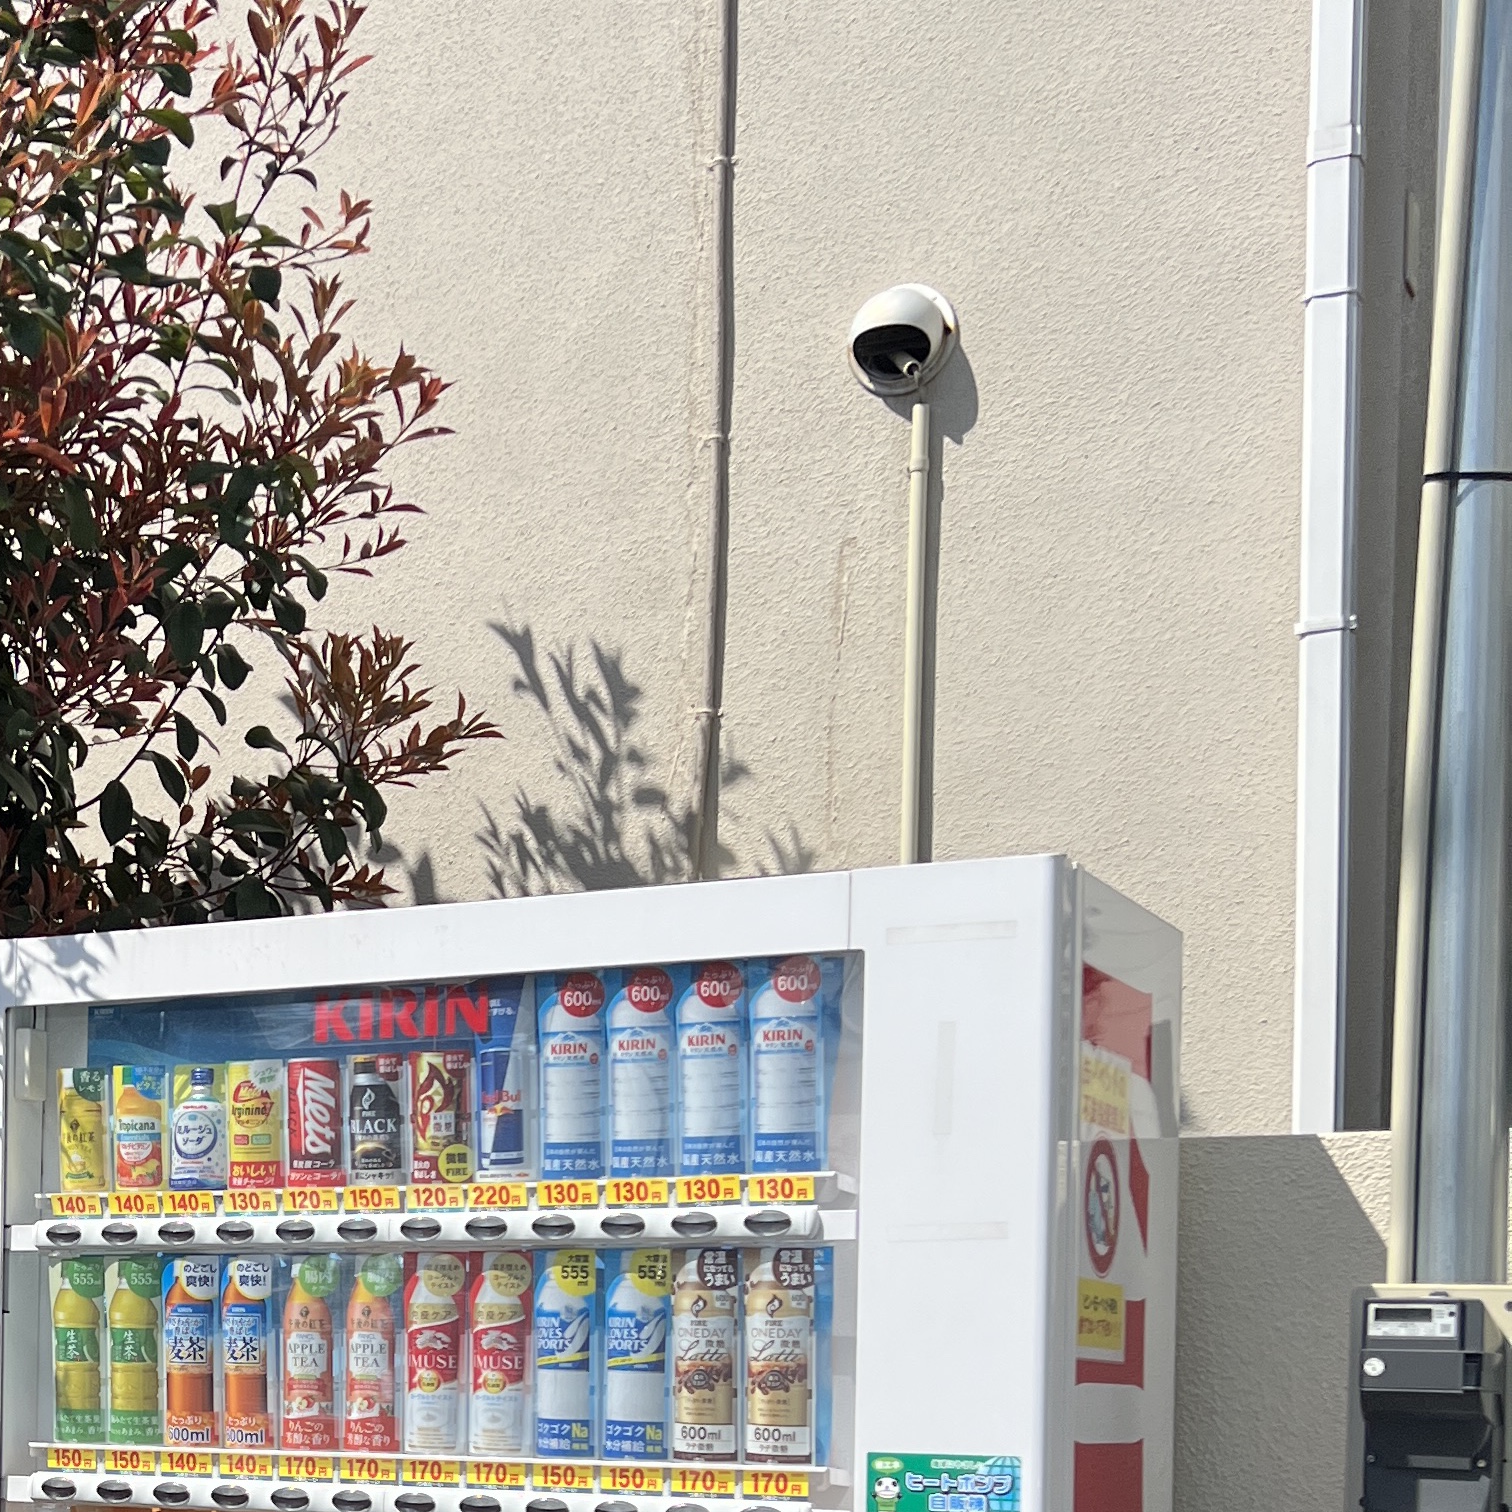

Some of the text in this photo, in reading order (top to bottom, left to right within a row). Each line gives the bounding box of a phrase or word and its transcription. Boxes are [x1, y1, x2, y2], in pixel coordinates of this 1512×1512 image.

[313, 984, 488, 1043] KIRIN
[687, 1033, 727, 1046] KIRIN
[762, 1029, 803, 1042] KIRIN
[550, 1042, 588, 1055] KIRIN
[618, 1038, 656, 1051] KIRIN
[304, 1067, 336, 1155] Mets
[177, 1124, 212, 1136] ミルージュ
[350, 1118, 398, 1134] BLACK
[182, 1135, 204, 1146] ソーダ
[445, 1168, 468, 1176] FIRE
[473, 1186, 521, 1205] 220円
[544, 1183, 592, 1204] 130円
[613, 1181, 661, 1202] 130円
[683, 1178, 734, 1199] 130円
[757, 1177, 807, 1199] 130円
[57, 1196, 96, 1213] 140円
[114, 1194, 155, 1212] 140円
[169, 1193, 210, 1212] 140円
[230, 1191, 271, 1211] 130円
[289, 1190, 332, 1209] 120円
[350, 1188, 394, 1207] 150円
[413, 1187, 459, 1207] 120円
[184, 1264, 217, 1273] のどごし
[237, 1263, 270, 1273] のどごし
[561, 1265, 589, 1280] 555
[638, 1265, 667, 1280] 555
[186, 1276, 214, 1287] 爽快!
[239, 1275, 266, 1287] 爽快!
[427, 1274, 459, 1282] ヨーグルト
[431, 1282, 455, 1290] テイスト
[493, 1274, 526, 1282] ヨーグルト
[497, 1282, 522, 1290] テイスト
[704, 1274, 737, 1287] うまい
[780, 1274, 812, 1287] うまい
[678, 1327, 728, 1339] ONEDAY
[751, 1327, 804, 1339] ONEDAY
[65, 1329, 80, 1360] 生茶
[123, 1330, 137, 1361] 生茶
[169, 1336, 205, 1361] 麦茶
[224, 1336, 259, 1361] 麦茶
[288, 1342, 326, 1354] APPLE
[350, 1342, 387, 1355] APPLE
[292, 1356, 319, 1368] TEA
[353, 1356, 381, 1368] TEA
[171, 1415, 202, 1424] たっぷり
[227, 1415, 256, 1426] たっぷり
[289, 1421, 324, 1433] りんごの
[349, 1422, 385, 1434] りんごの
[571, 1422, 589, 1439] Na
[606, 1425, 645, 1437] ゴクゴク
[645, 1424, 663, 1441] Na
[680, 1426, 722, 1441] 600ml
[754, 1427, 796, 1442] 600ml
[54, 1449, 92, 1468] 150円
[112, 1451, 151, 1470] 150円
[168, 1452, 208, 1471] 140円
[226, 1454, 267, 1475] 140円
[286, 1456, 327, 1477] 170円
[347, 1458, 390, 1479] 170円
[410, 1460, 454, 1481] 170円
[475, 1463, 519, 1484] 170円
[542, 1465, 587, 1487] 150円
[610, 1468, 657, 1490] 150円
[679, 1470, 728, 1492] 170円
[752, 1472, 802, 1495] 170円
[905, 1471, 1013, 1495] ヒートポンプ
